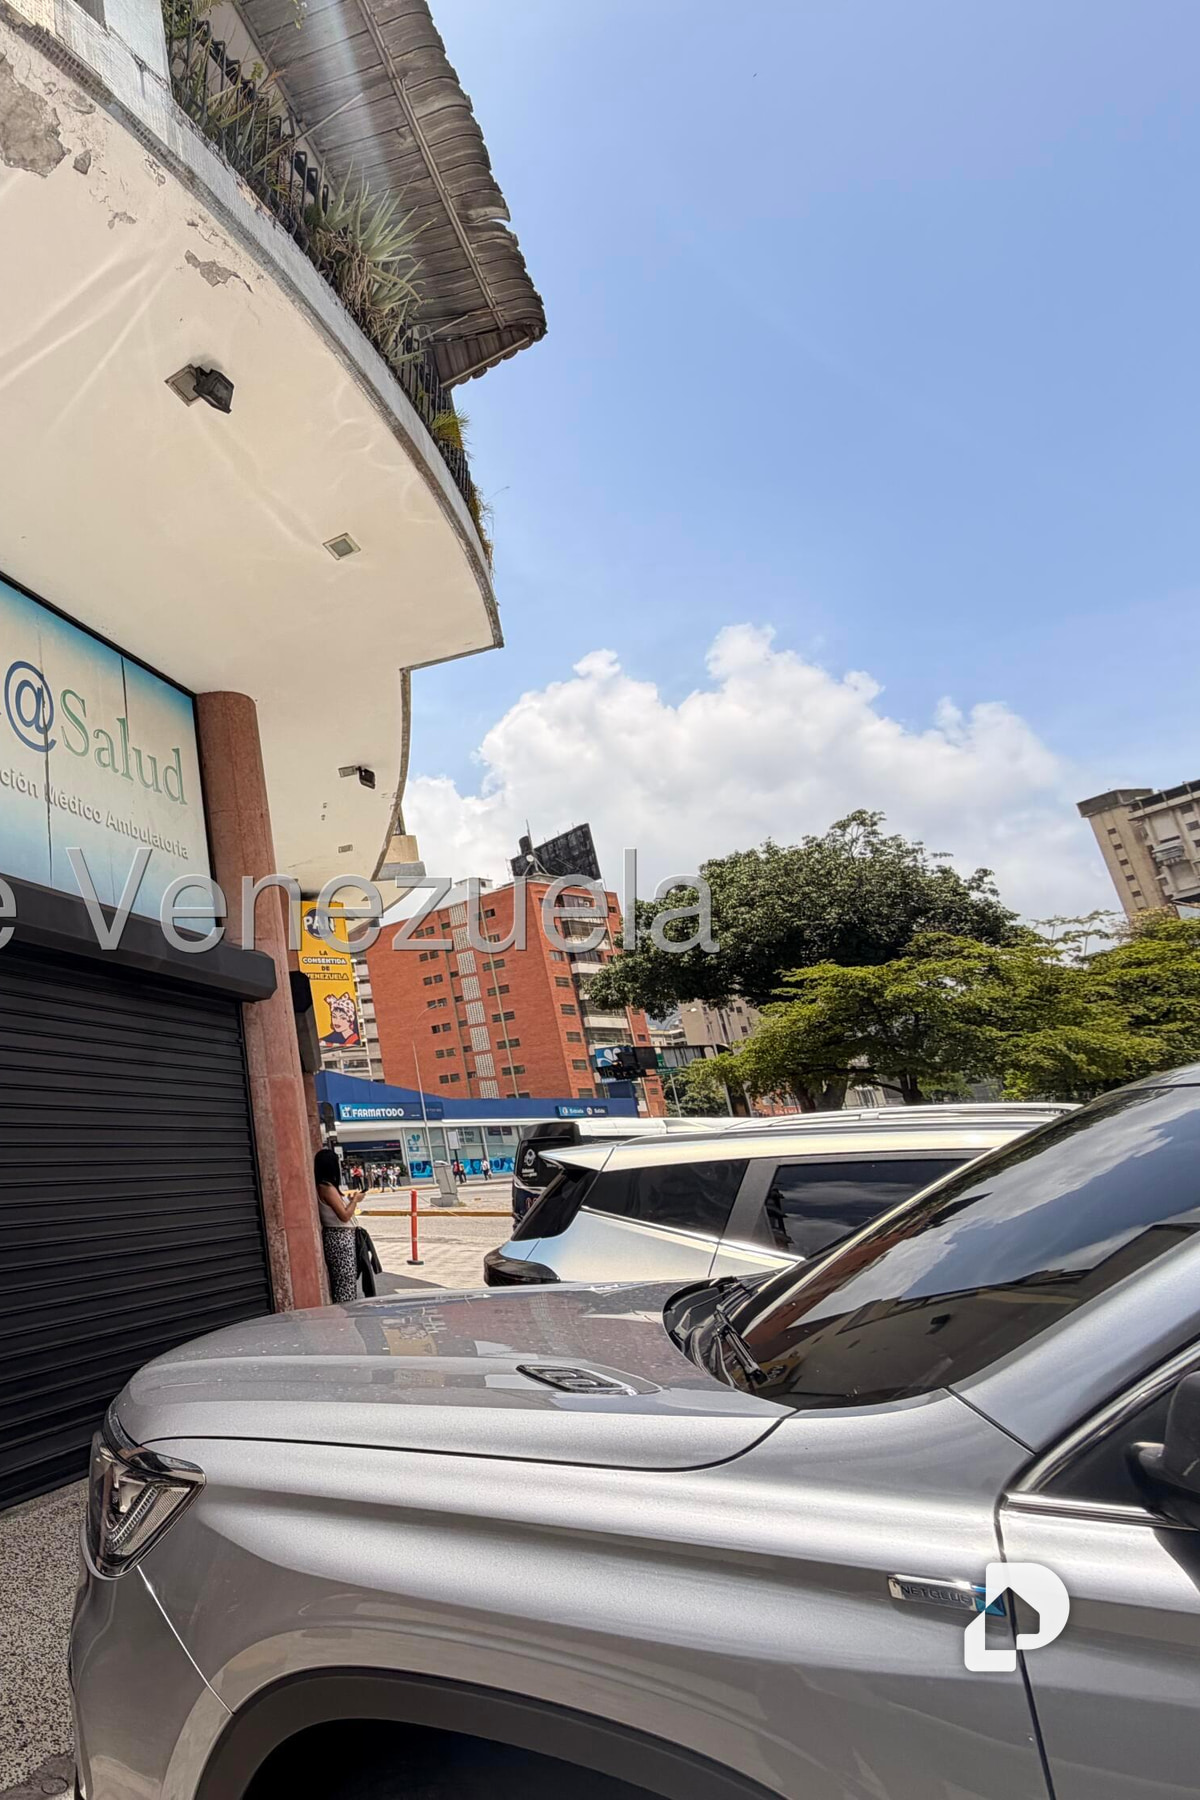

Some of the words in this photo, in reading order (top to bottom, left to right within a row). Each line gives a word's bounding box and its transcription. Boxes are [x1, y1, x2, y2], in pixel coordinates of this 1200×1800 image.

[43, 784, 102, 825] Médico
[106, 810, 189, 860] Ambulatoria
[307, 972, 349, 981] VENEZUELA
[352, 1107, 405, 1118] FARMATODO
